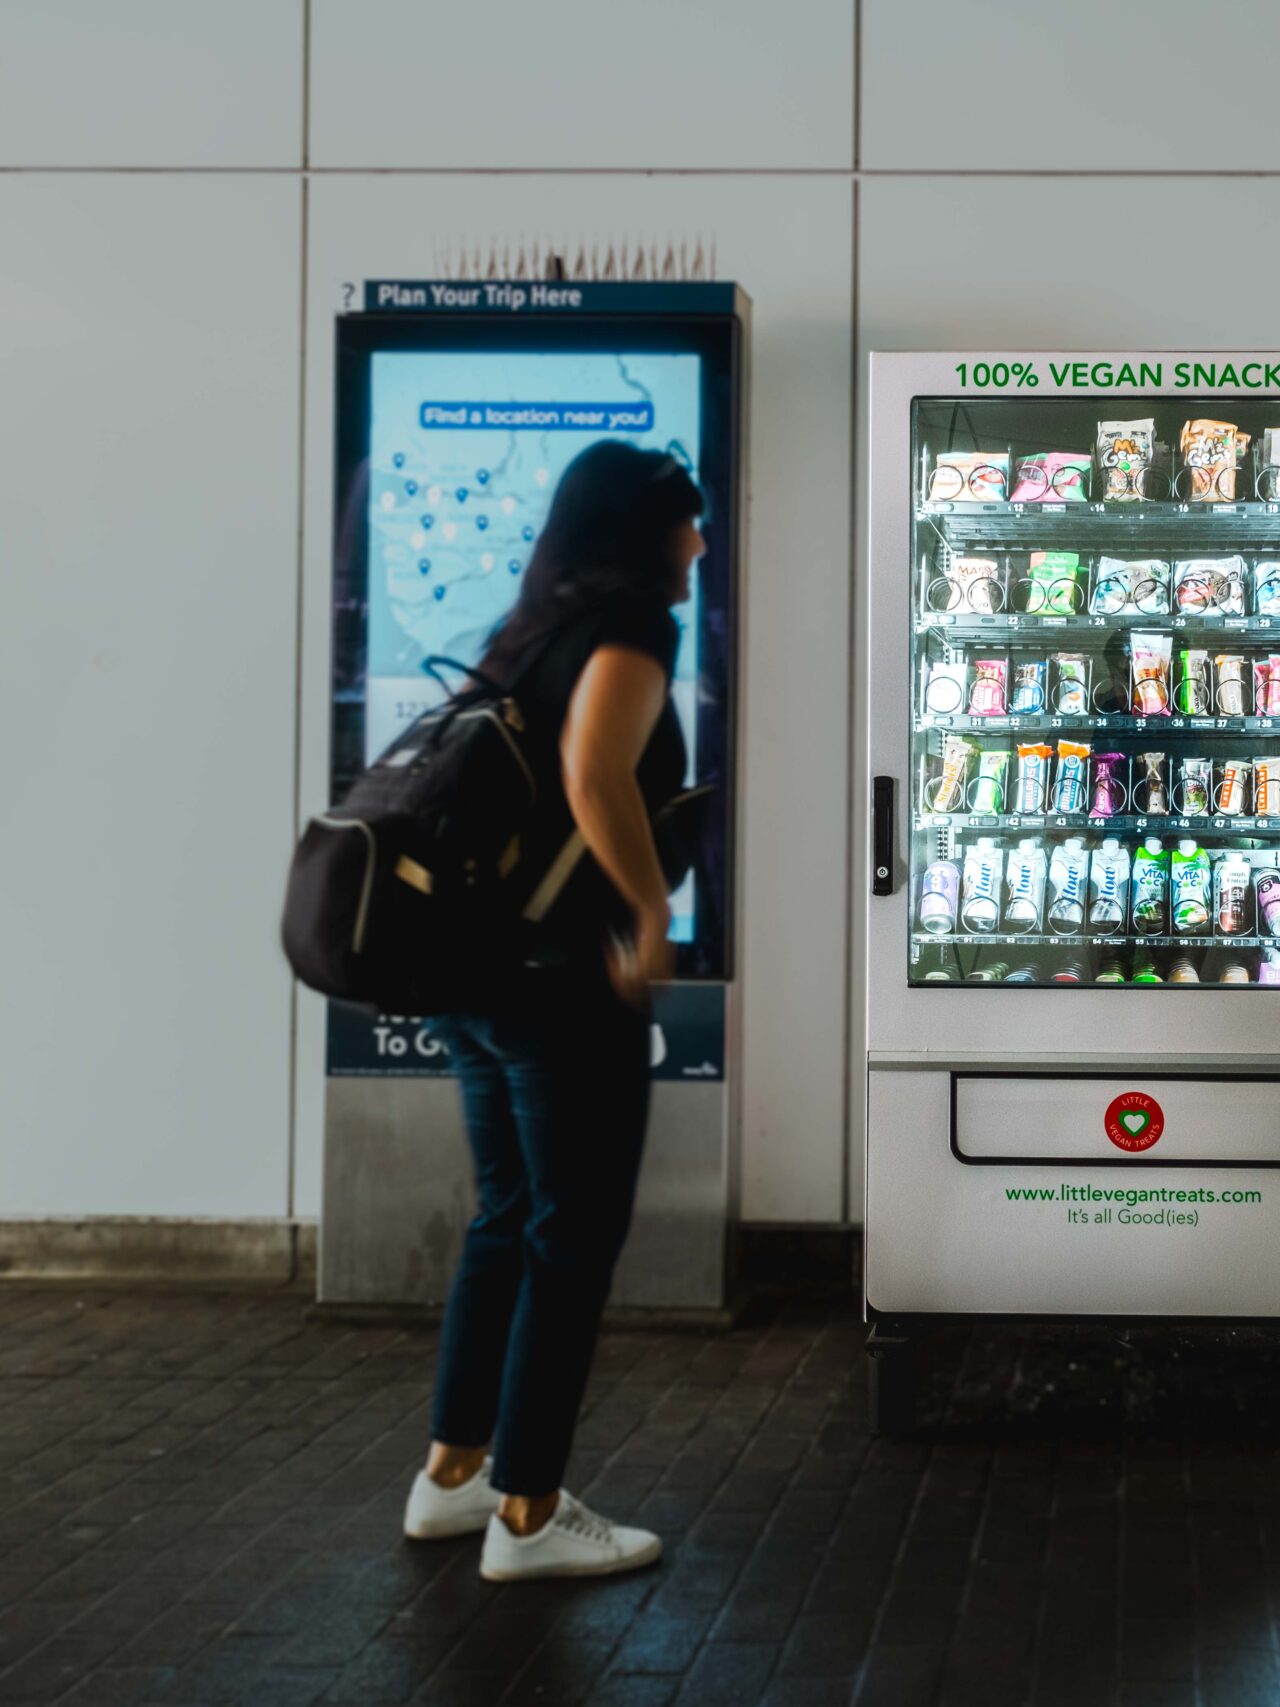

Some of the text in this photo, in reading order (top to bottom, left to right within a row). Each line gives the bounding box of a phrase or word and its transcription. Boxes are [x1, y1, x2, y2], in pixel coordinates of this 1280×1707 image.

[378, 284, 582, 311] Plan Your Trip Here
[955, 362, 1039, 388] 100%
[1048, 363, 1163, 388] VEGAN
[425, 407, 649, 429] Find a location near you!
[1013, 504, 1024, 512] 12
[1094, 504, 1105, 512] 14
[1178, 504, 1189, 513] 16
[1008, 616, 1019, 625] 22
[1094, 618, 1105, 626] 24
[1175, 618, 1186, 627] 26
[1259, 619, 1271, 628] 28
[971, 717, 982, 726] 31
[1010, 717, 1020, 726] 32
[1051, 718, 1062, 727] 33
[1096, 719, 1107, 727] 34
[1136, 719, 1146, 727] 35
[1174, 719, 1184, 727] 36
[1217, 719, 1228, 728] 37
[1261, 719, 1272, 728] 38
[969, 817, 979, 826] 41
[1009, 817, 1019, 826] 42
[1056, 818, 1066, 826] 43
[1095, 818, 1105, 826] 44
[1136, 819, 1147, 827] 45
[1179, 819, 1189, 827] 46
[1214, 819, 1225, 827] 47
[1257, 819, 1268, 827] 48
[1142, 868, 1164, 880] VITA
[1177, 871, 1200, 880] VITA
[1015, 865, 1031, 896] low
[372, 1027, 450, 1058] To G
[1121, 1096, 1151, 1108] LITTLE
[1109, 1123, 1160, 1148] VEGAN TREATS
[1005, 1184, 1262, 1207] www.littlevegantreats.com
[1067, 1208, 1200, 1227] It's all Good(ies)
